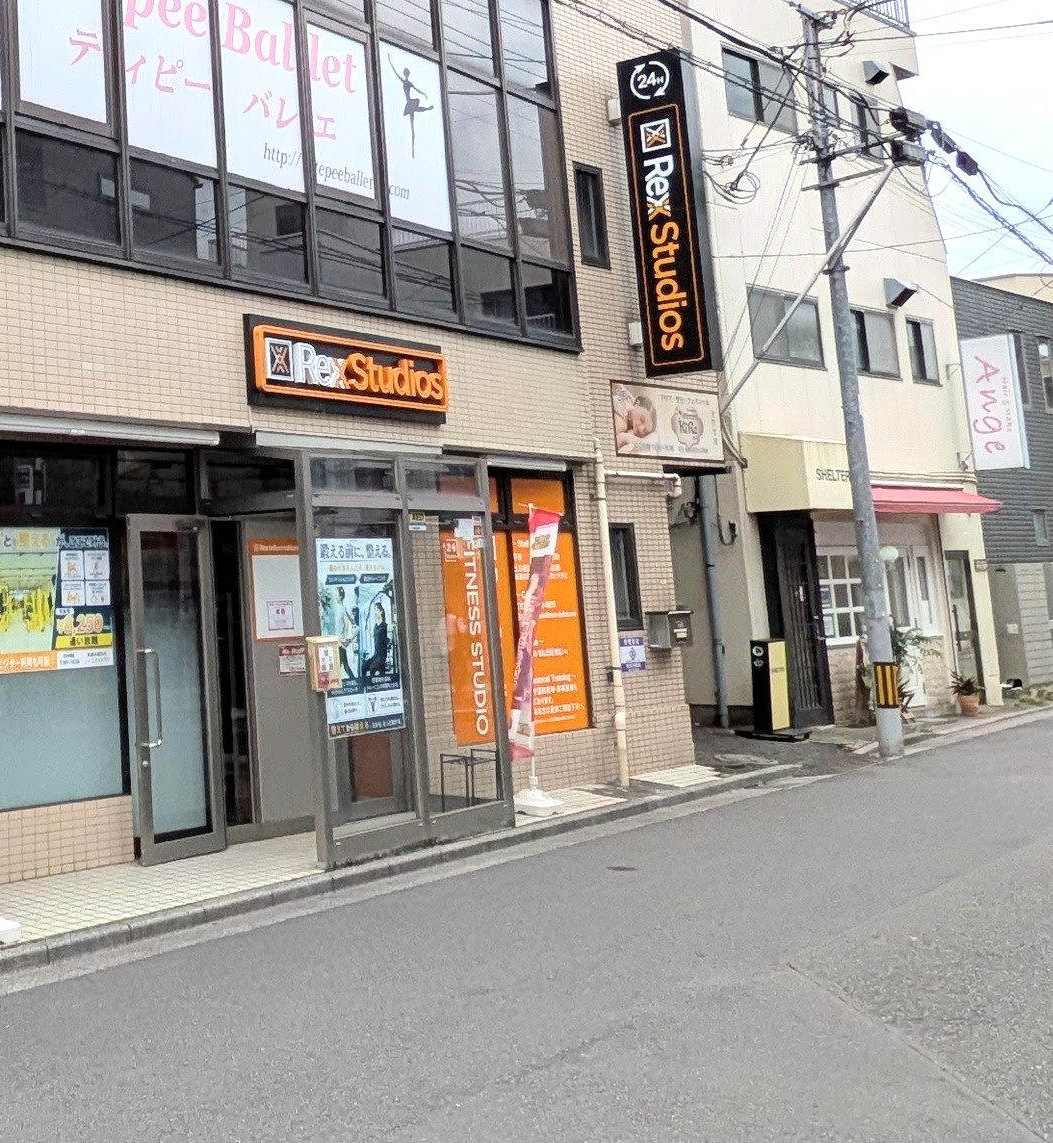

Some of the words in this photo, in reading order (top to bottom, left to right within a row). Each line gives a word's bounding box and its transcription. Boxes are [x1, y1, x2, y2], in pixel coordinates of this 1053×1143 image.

[68, 28, 212, 94] ティピー
[241, 90, 338, 141] バレエ
[221, 1, 358, 95] Ballet
[636, 71, 665, 90] 24H
[643, 154, 675, 222] Rex
[650, 221, 688, 351] Studios
[346, 352, 445, 400] Studios
[471, 642, 489, 735] STUDIO
